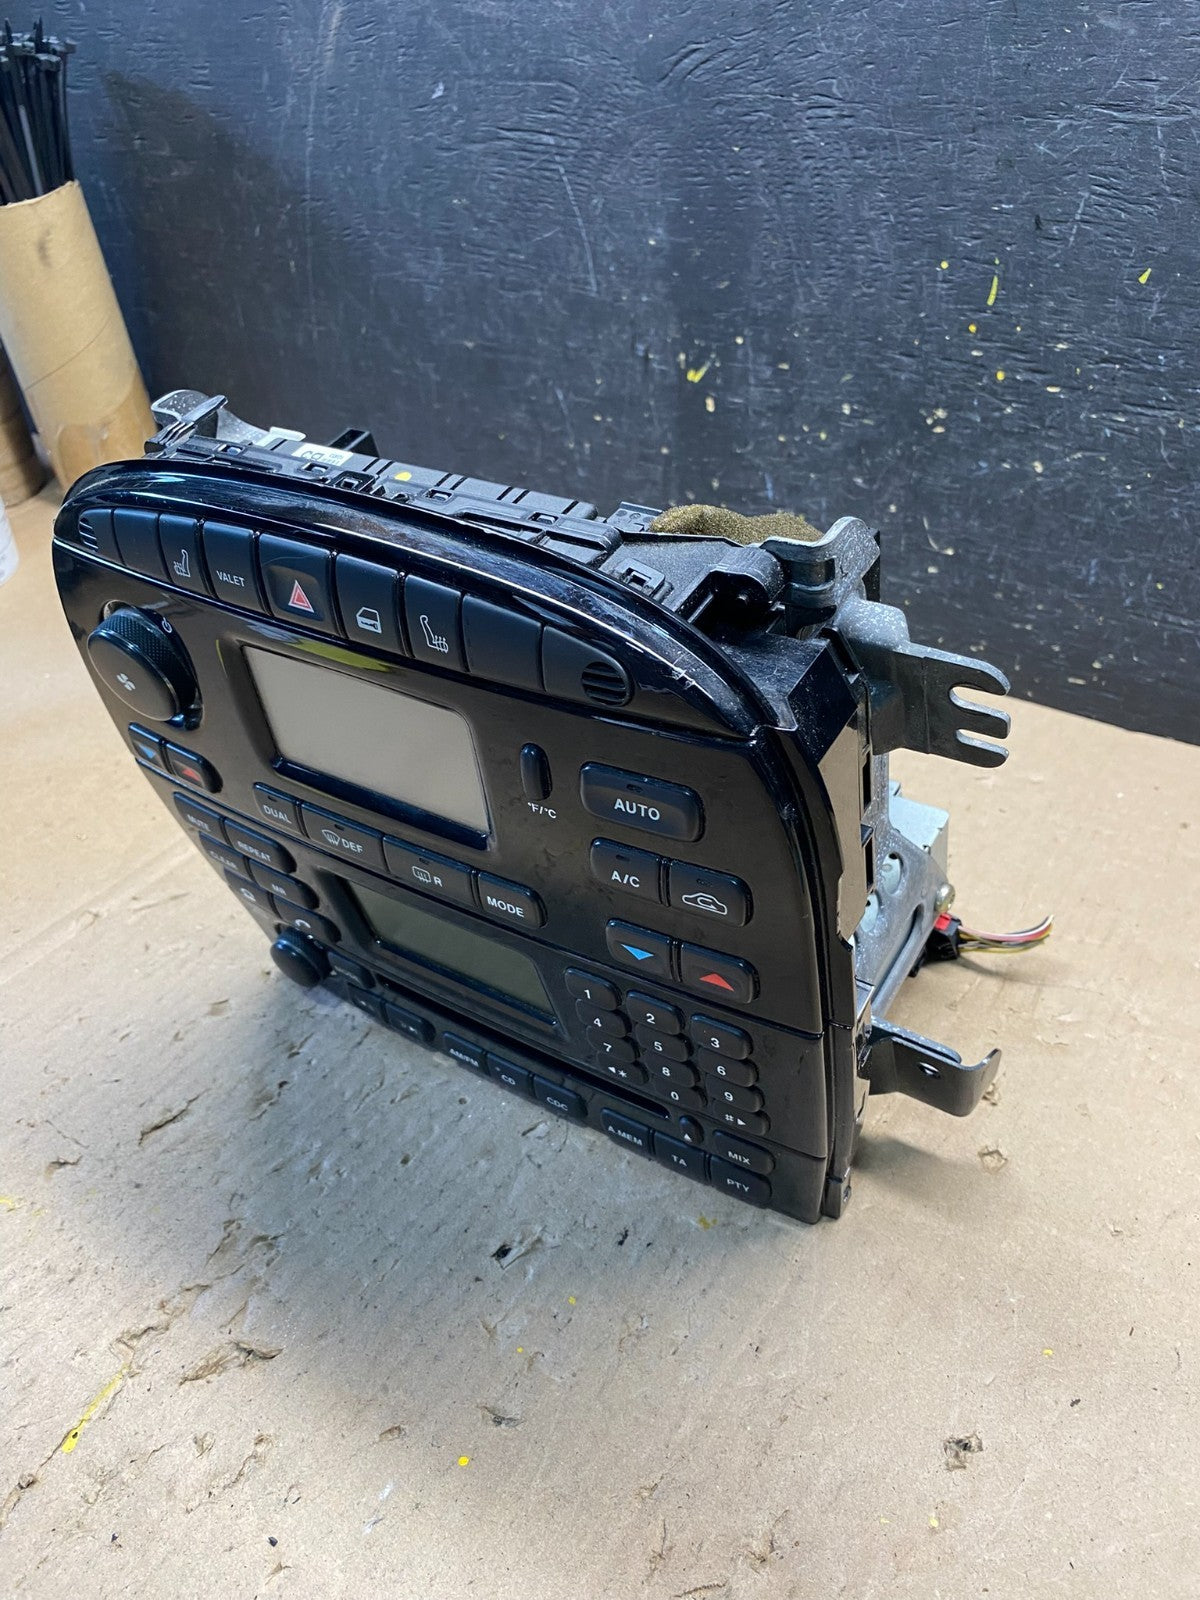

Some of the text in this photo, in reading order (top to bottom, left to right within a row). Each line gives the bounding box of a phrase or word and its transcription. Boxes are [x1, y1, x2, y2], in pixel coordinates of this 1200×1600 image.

[216, 570, 245, 587] VALET
[263, 805, 291, 824] DUAL
[614, 798, 660, 821] AUTO
[237, 841, 271, 862] REPEAT
[342, 838, 363, 854] DEF
[434, 875, 442, 887] R
[611, 870, 640, 888] A/C
[487, 896, 525, 918] MODE
[584, 989, 591, 999] 1
[593, 1018, 602, 1027] 4
[646, 1013, 655, 1024] 2
[603, 1043, 612, 1052] 7
[654, 1041, 663, 1051] 5
[711, 1037, 720, 1048] 3
[662, 1067, 671, 1077] 8
[716, 1065, 726, 1076] 6
[501, 1074, 515, 1085] CD
[724, 1092, 733, 1101] 9
[546, 1096, 568, 1111] CDC
[671, 1155, 687, 1167] TA
[728, 1151, 751, 1165] MIX
[726, 1179, 750, 1192] PTY
